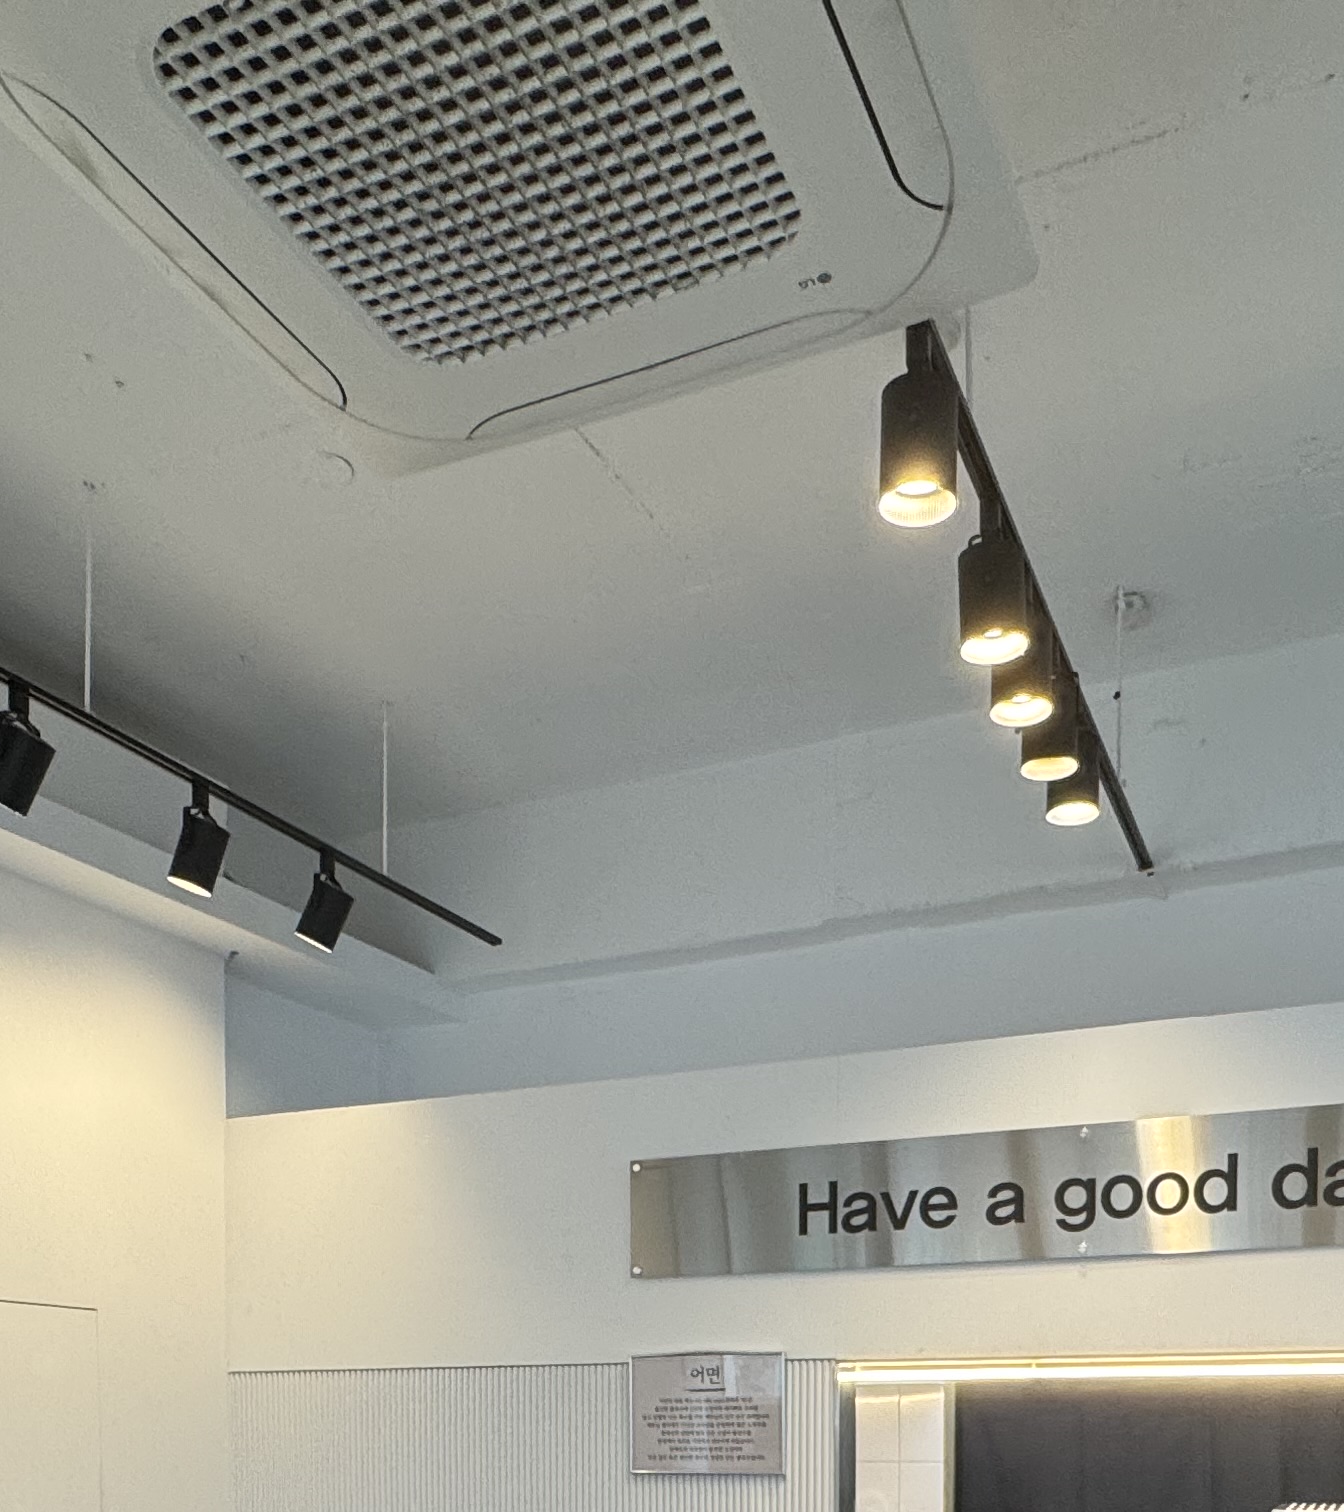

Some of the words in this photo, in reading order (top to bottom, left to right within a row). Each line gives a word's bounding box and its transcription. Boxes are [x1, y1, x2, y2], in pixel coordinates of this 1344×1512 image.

[798, 1180, 958, 1236] Have
[986, 1178, 1027, 1225] a
[1055, 1153, 1239, 1231] good
